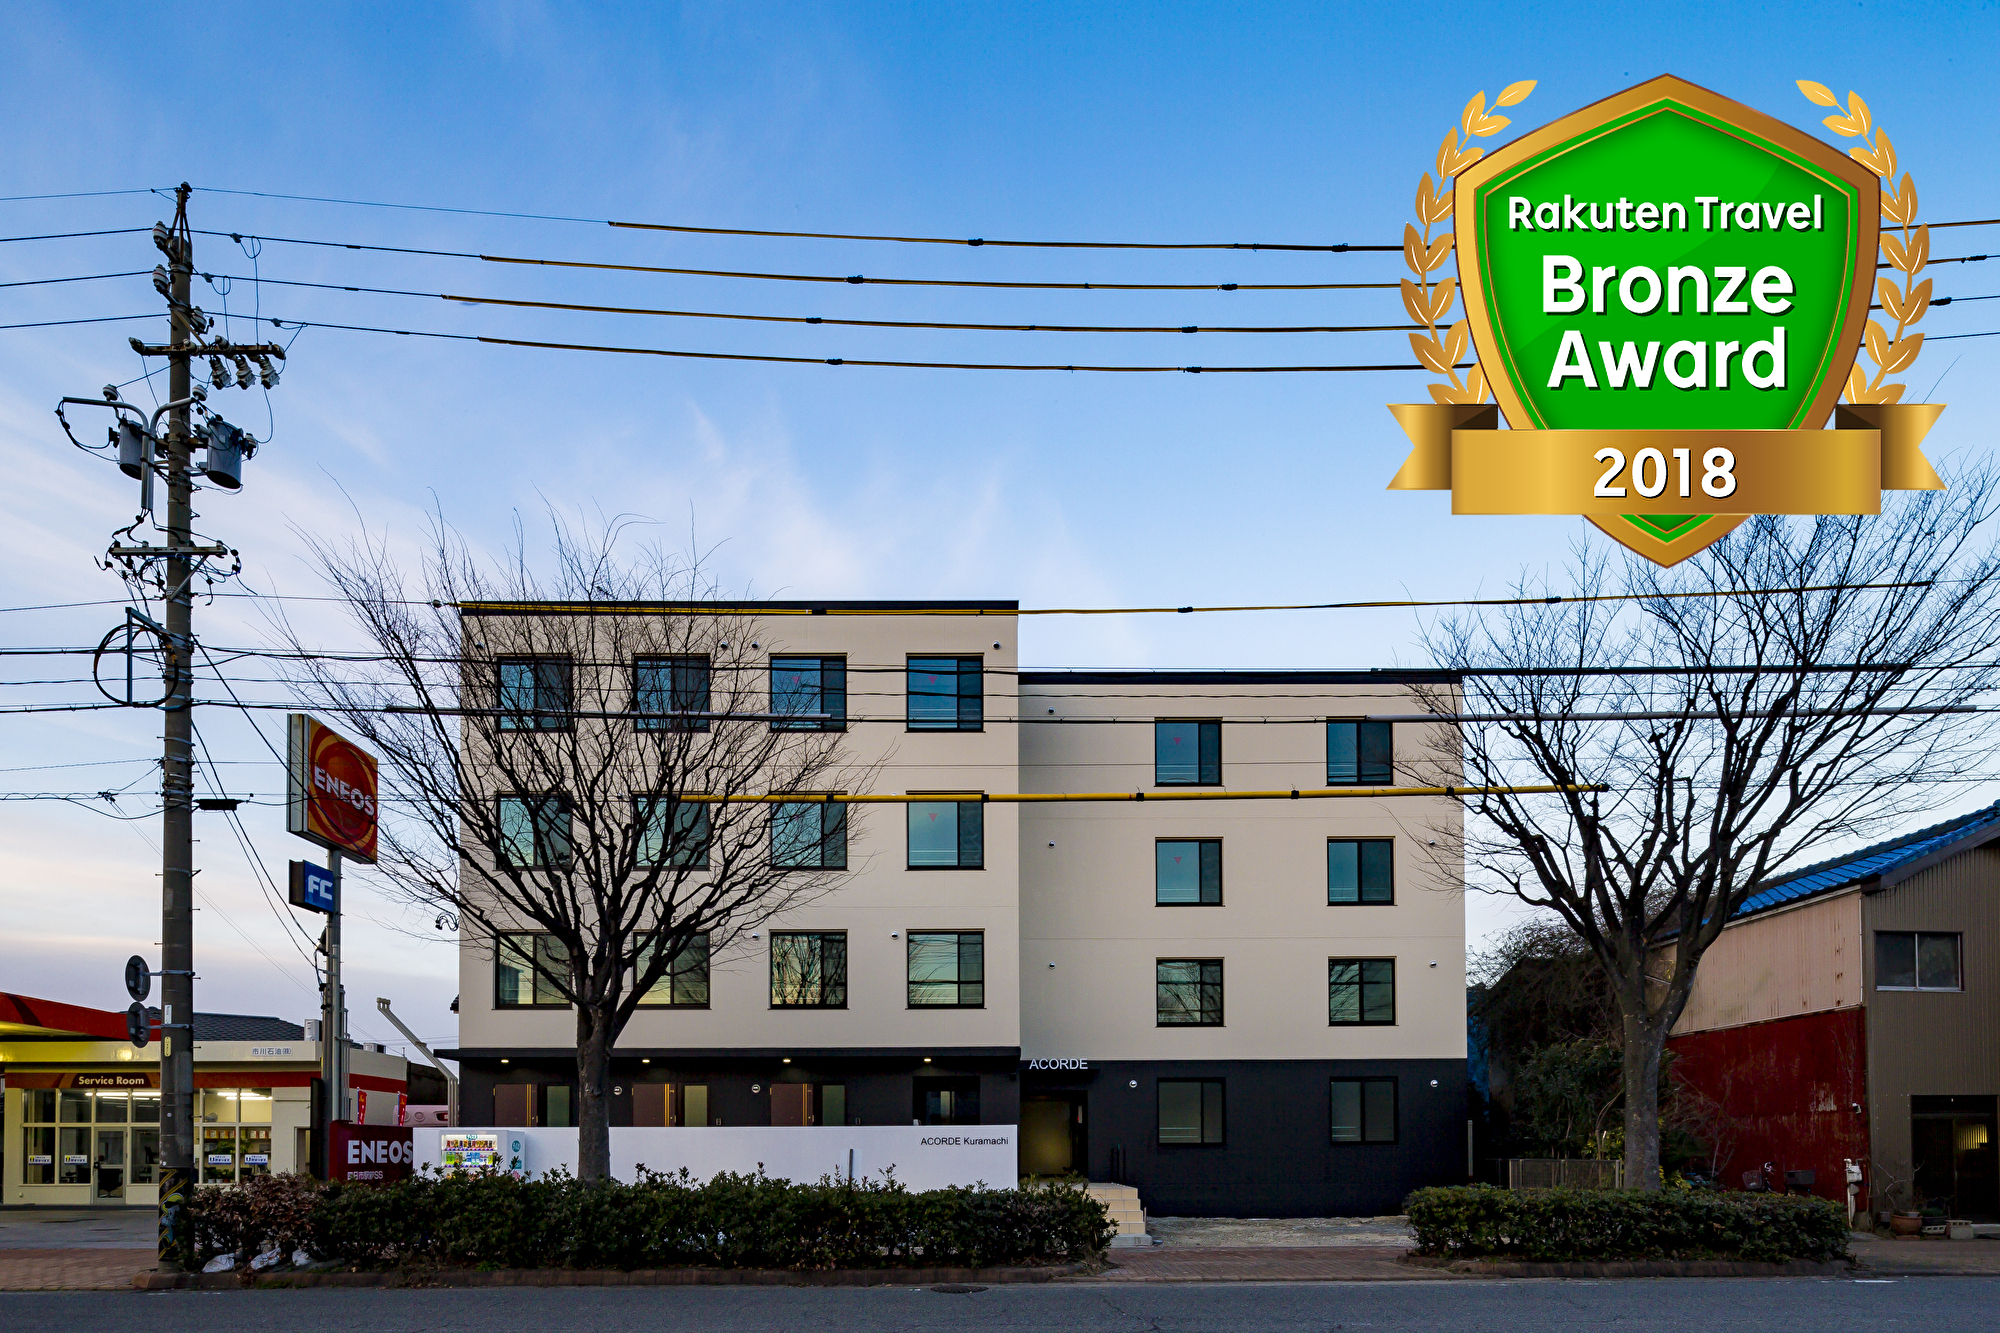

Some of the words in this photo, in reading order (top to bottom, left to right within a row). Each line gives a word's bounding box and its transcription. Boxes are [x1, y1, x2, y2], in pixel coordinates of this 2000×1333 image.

[313, 765, 375, 816] ENEOS
[307, 874, 334, 900] FC
[1029, 1058, 1089, 1070] ACORDE
[78, 1075, 114, 1085] Service
[116, 1076, 145, 1085] Room
[920, 1136, 961, 1146] ACORDE
[963, 1136, 1009, 1146] Kuramachi
[347, 1139, 413, 1164] ENEOS
